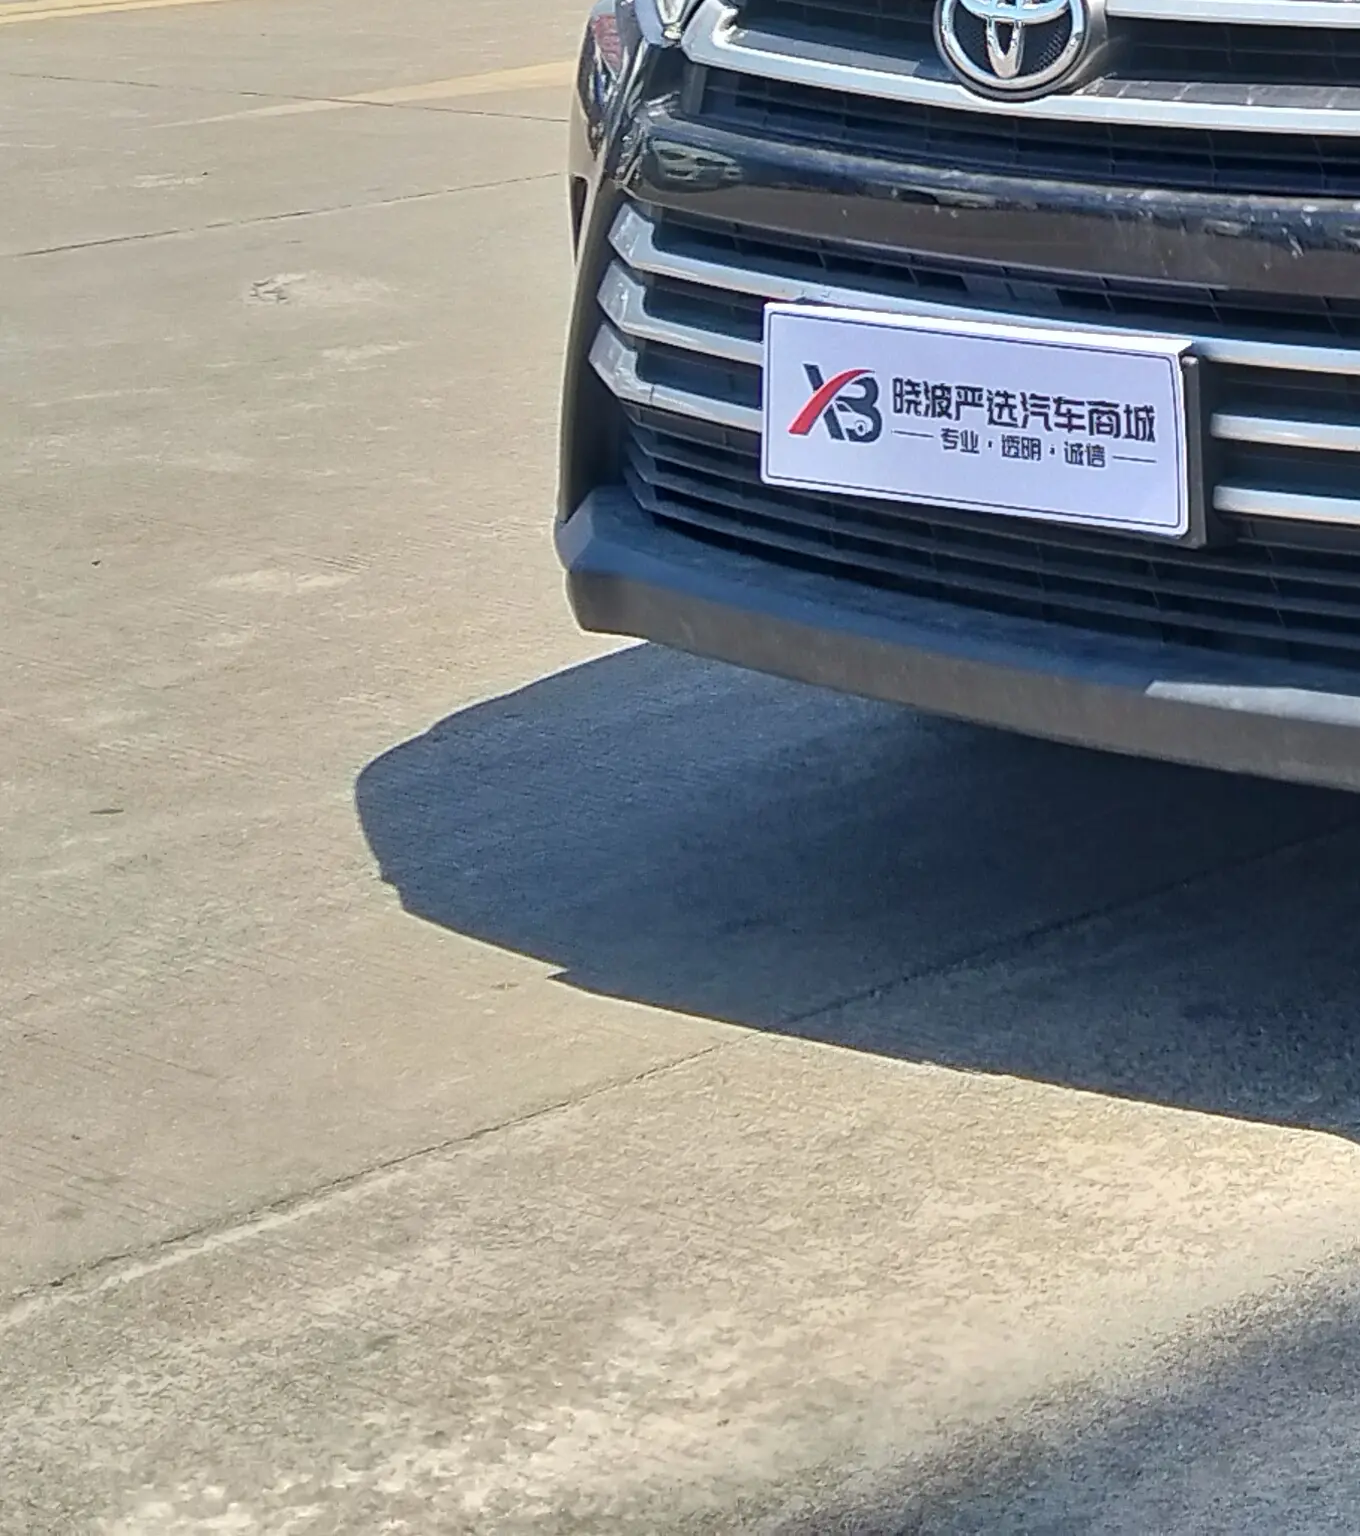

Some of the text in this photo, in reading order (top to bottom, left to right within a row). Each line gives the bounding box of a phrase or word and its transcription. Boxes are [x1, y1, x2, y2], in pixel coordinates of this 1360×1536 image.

[892, 378, 1156, 442] 晓波严选汽车商城
